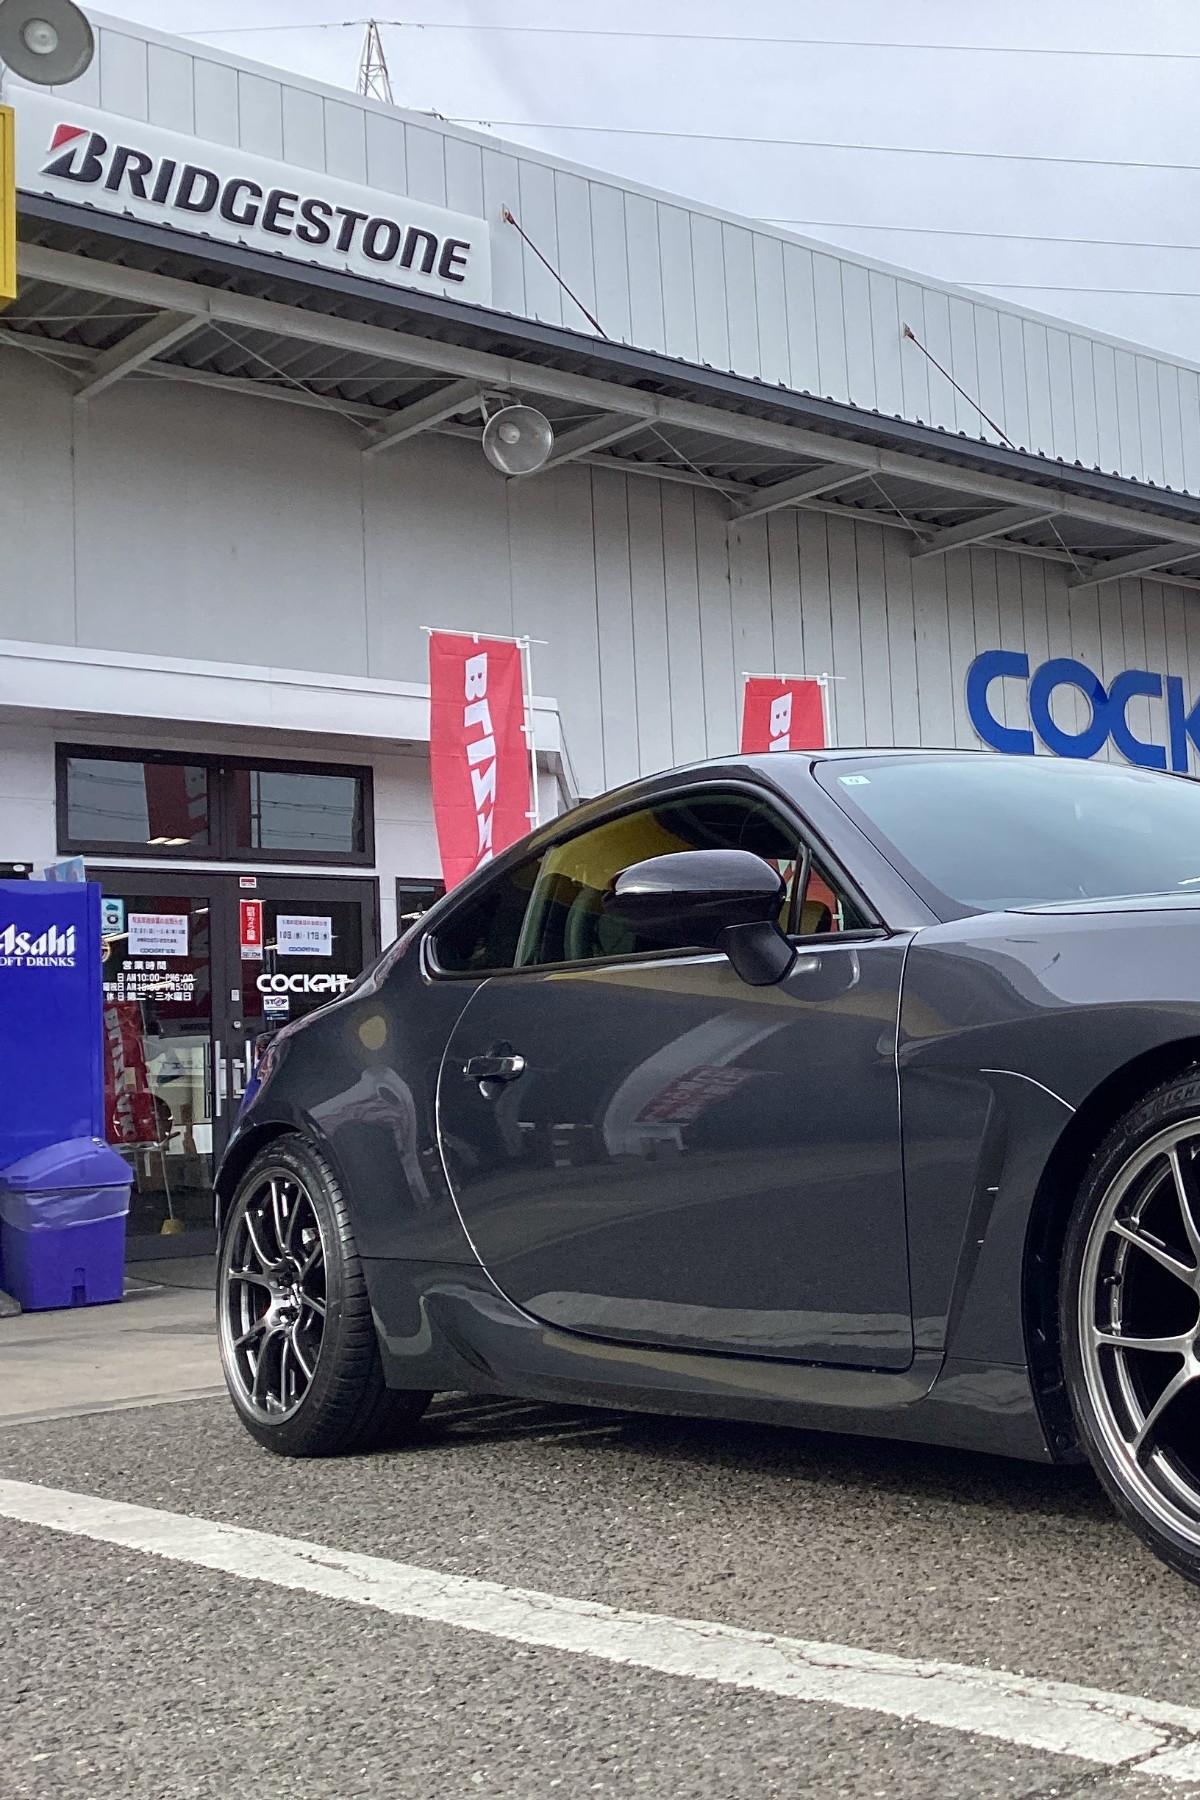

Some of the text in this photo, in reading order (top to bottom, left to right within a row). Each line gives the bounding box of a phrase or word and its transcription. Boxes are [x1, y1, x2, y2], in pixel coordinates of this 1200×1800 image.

[40, 123, 471, 283] BRIDGESTONE
[0, 923, 76, 957] Asahi
[27, 957, 75, 968] DRINKS
[256, 973, 348, 993] COCKPIT
